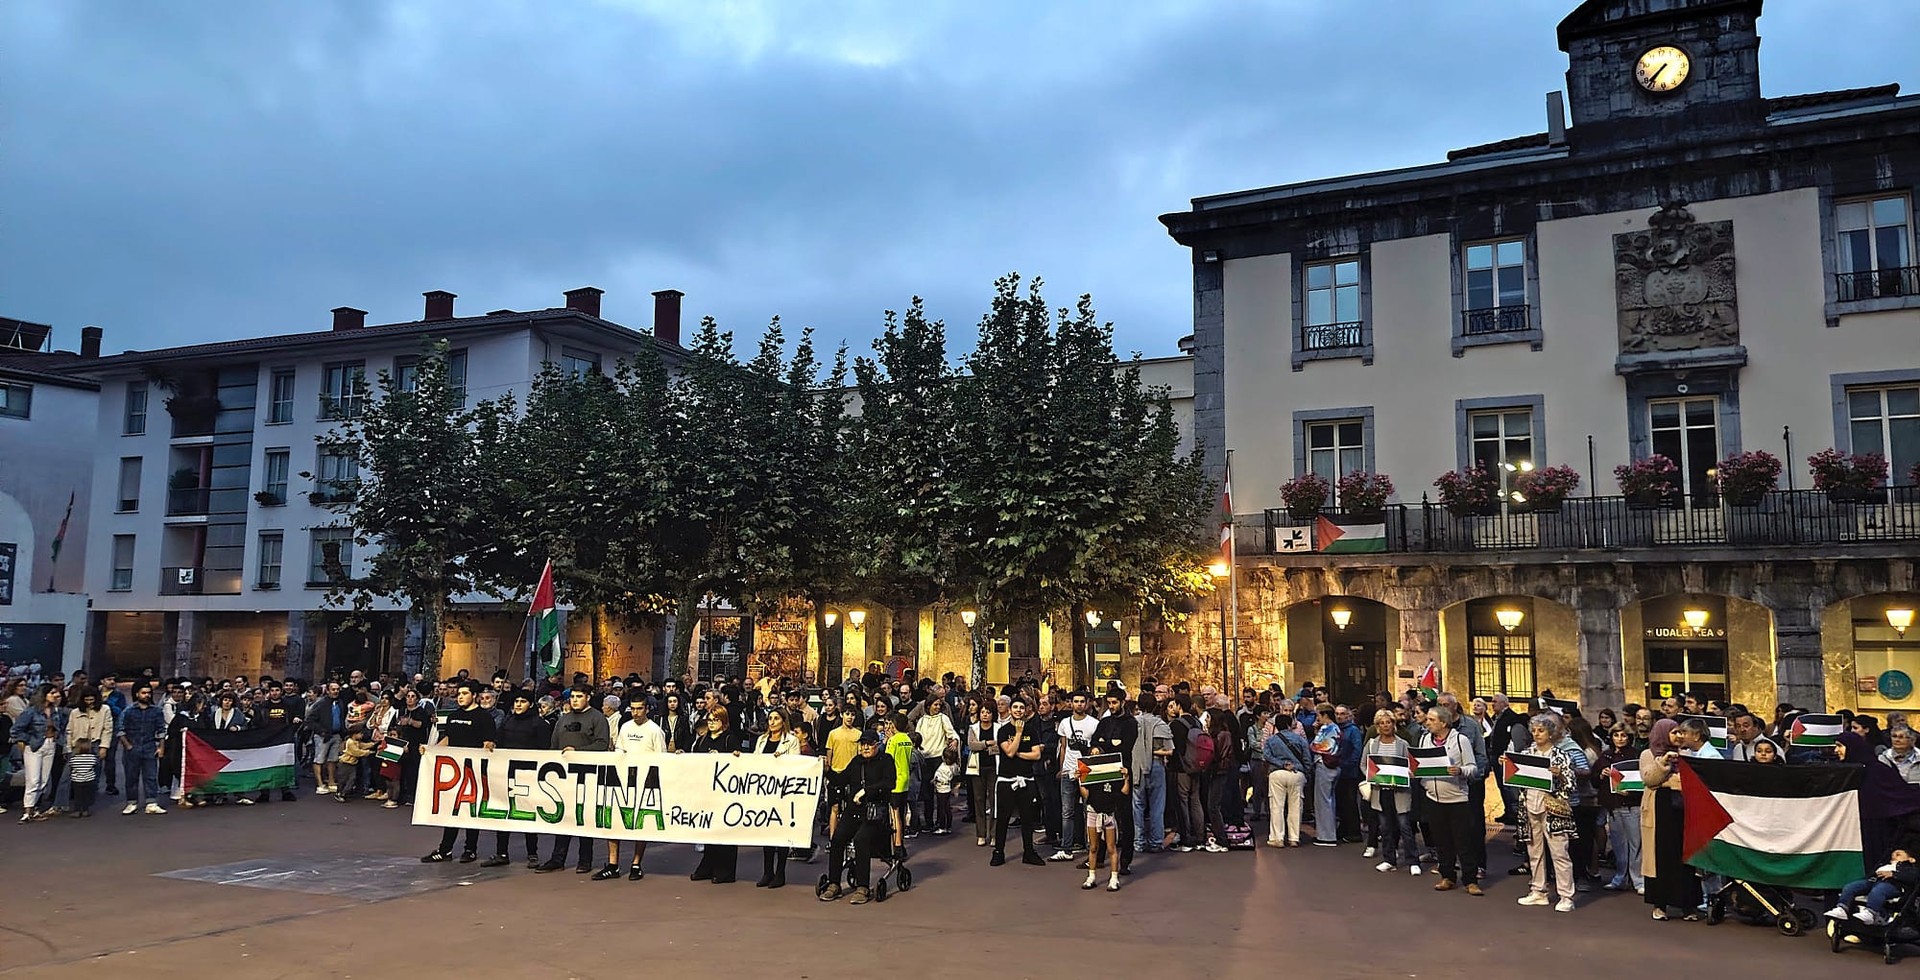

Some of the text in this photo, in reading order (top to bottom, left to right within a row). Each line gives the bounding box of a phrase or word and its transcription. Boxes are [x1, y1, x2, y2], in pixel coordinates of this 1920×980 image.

[1655, 628, 1714, 637] UDALETEA
[432, 755, 665, 830] PALESTINA
[713, 761, 819, 798] KONPROMEZU
